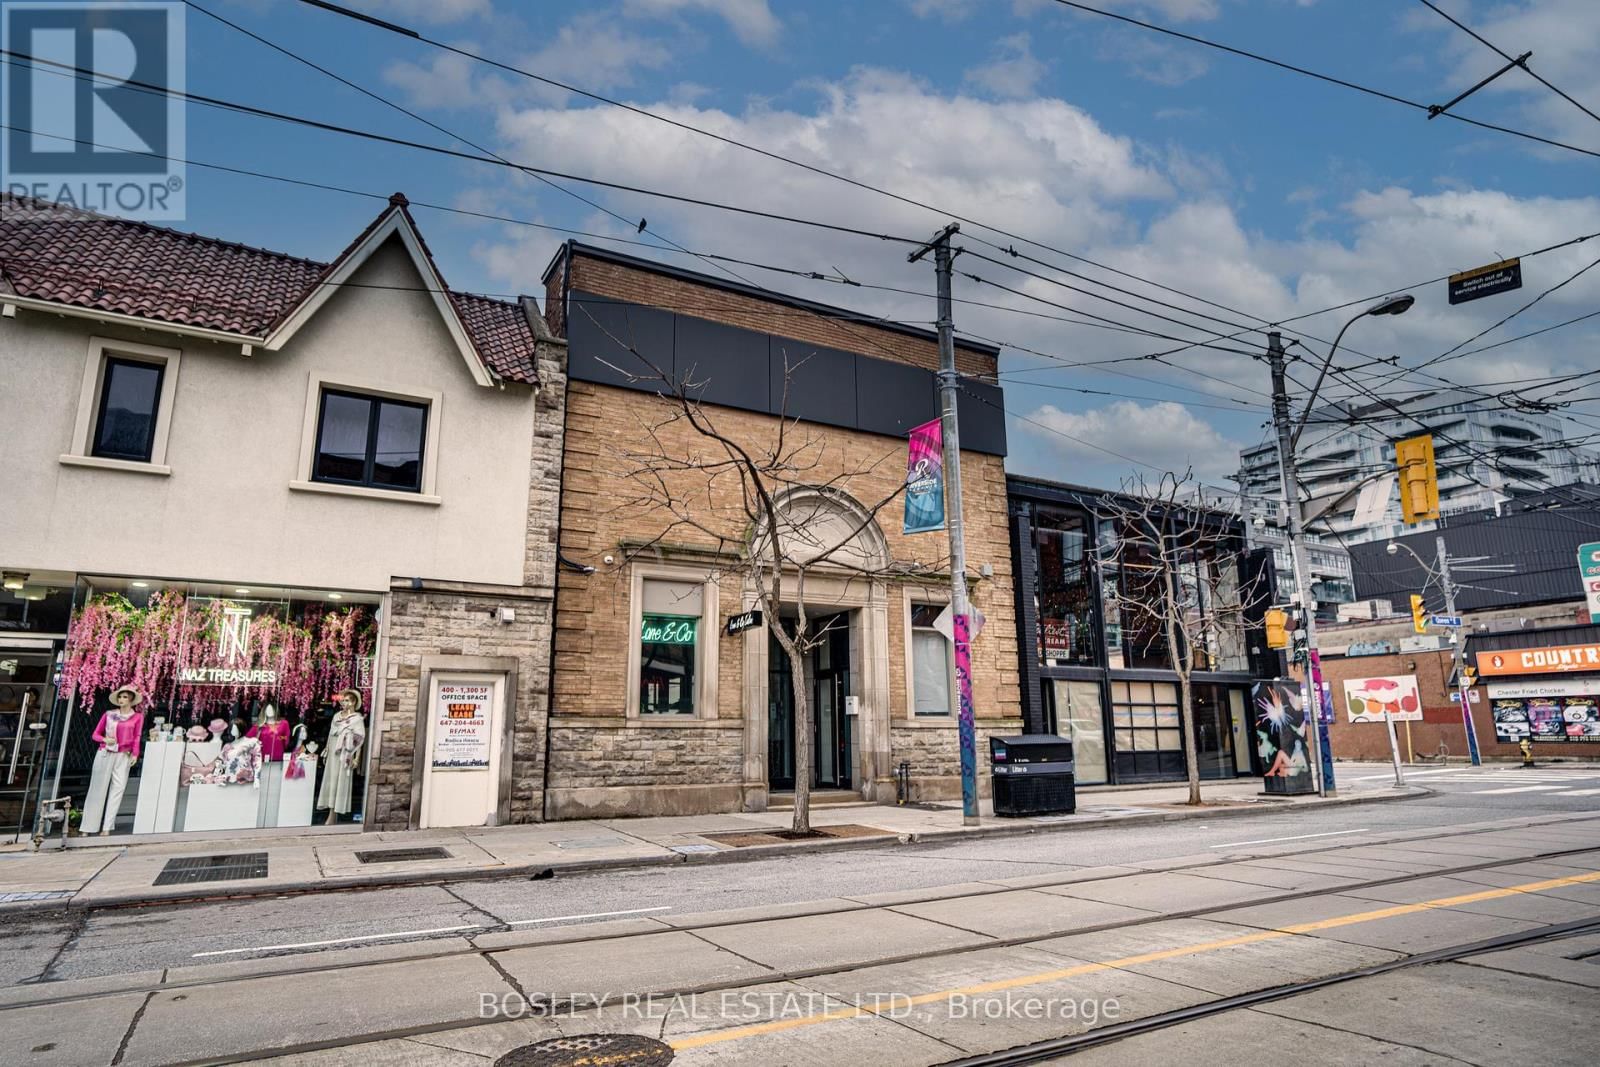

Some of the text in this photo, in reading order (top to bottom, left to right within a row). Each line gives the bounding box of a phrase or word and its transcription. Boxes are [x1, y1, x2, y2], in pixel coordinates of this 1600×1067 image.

[662, 621, 677, 641] &
[677, 622, 693, 641] Co
[182, 669, 276, 682] NAZ TREASURES
